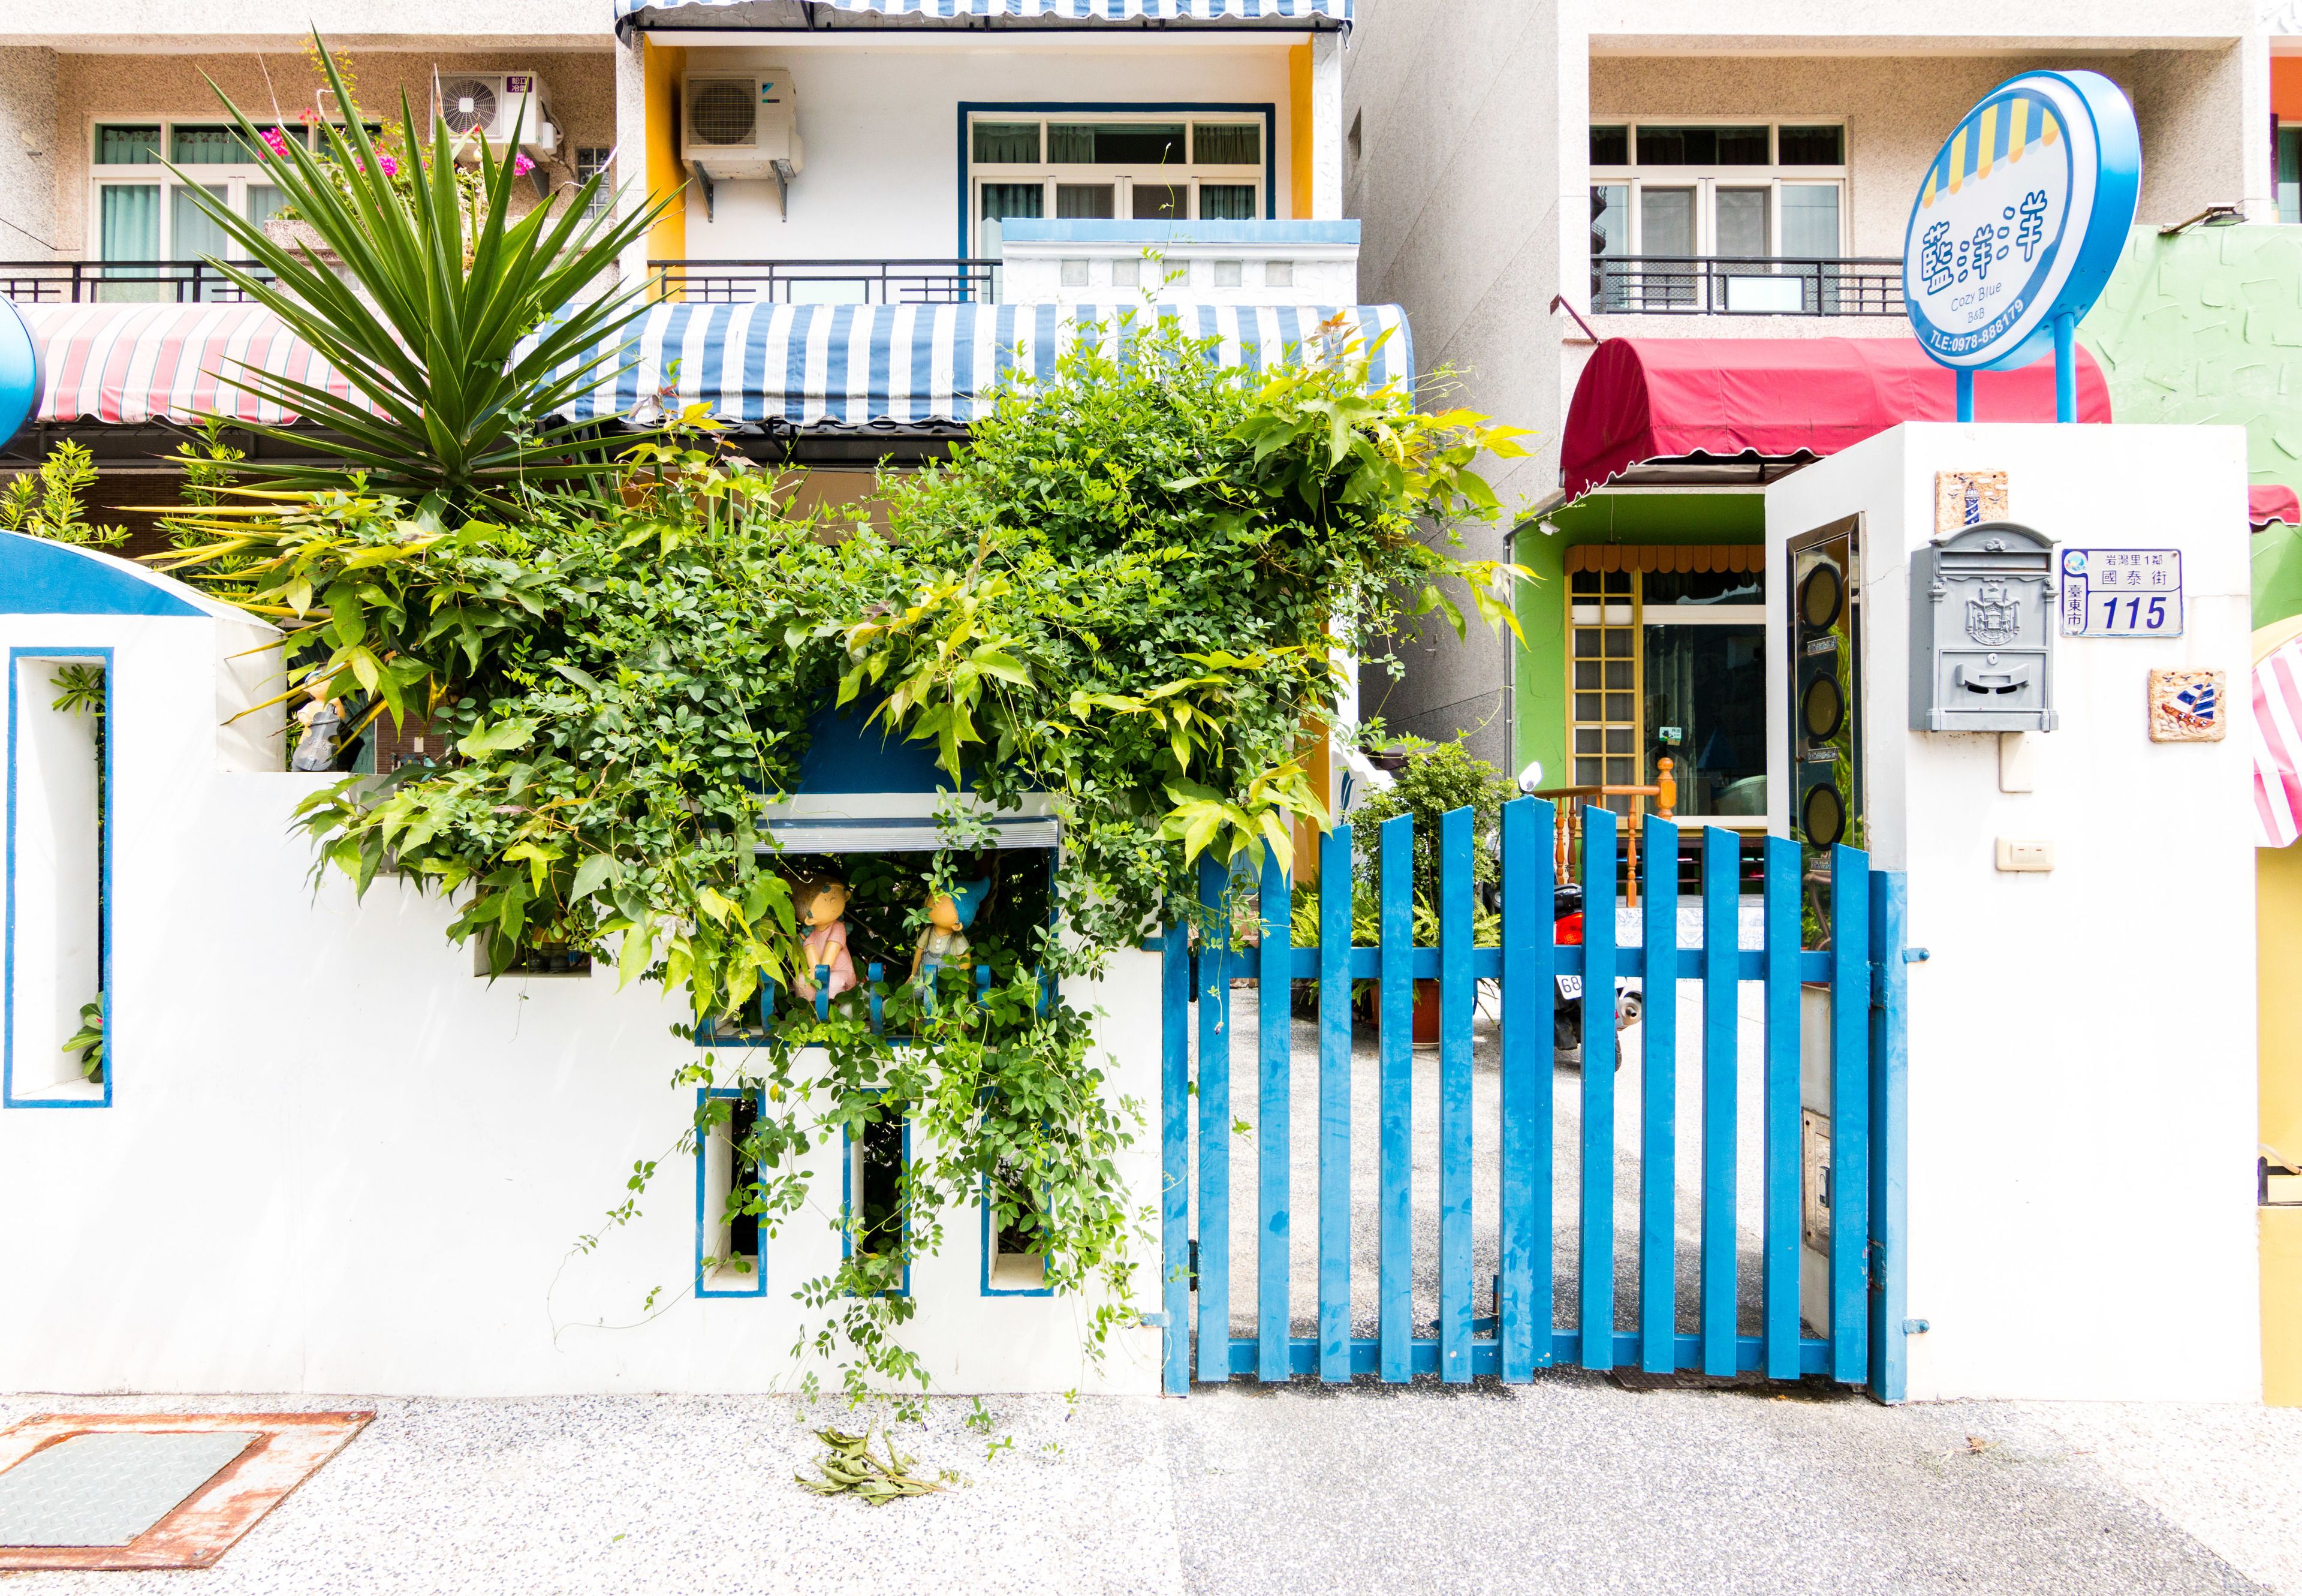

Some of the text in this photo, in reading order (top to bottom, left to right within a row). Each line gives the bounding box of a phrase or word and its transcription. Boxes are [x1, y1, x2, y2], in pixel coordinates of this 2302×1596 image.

[1921, 189, 2048, 296] 藍洋洋
[1951, 282, 2002, 312] Cozy Blue
[1930, 299, 2024, 352] TLE:0978-888179
[1967, 307, 1985, 324] B&B
[2102, 570, 2167, 585] 國泰街
[2067, 584, 2083, 626] 臺東市
[2103, 597, 2167, 630] 115
[1561, 976, 1582, 993] 68
